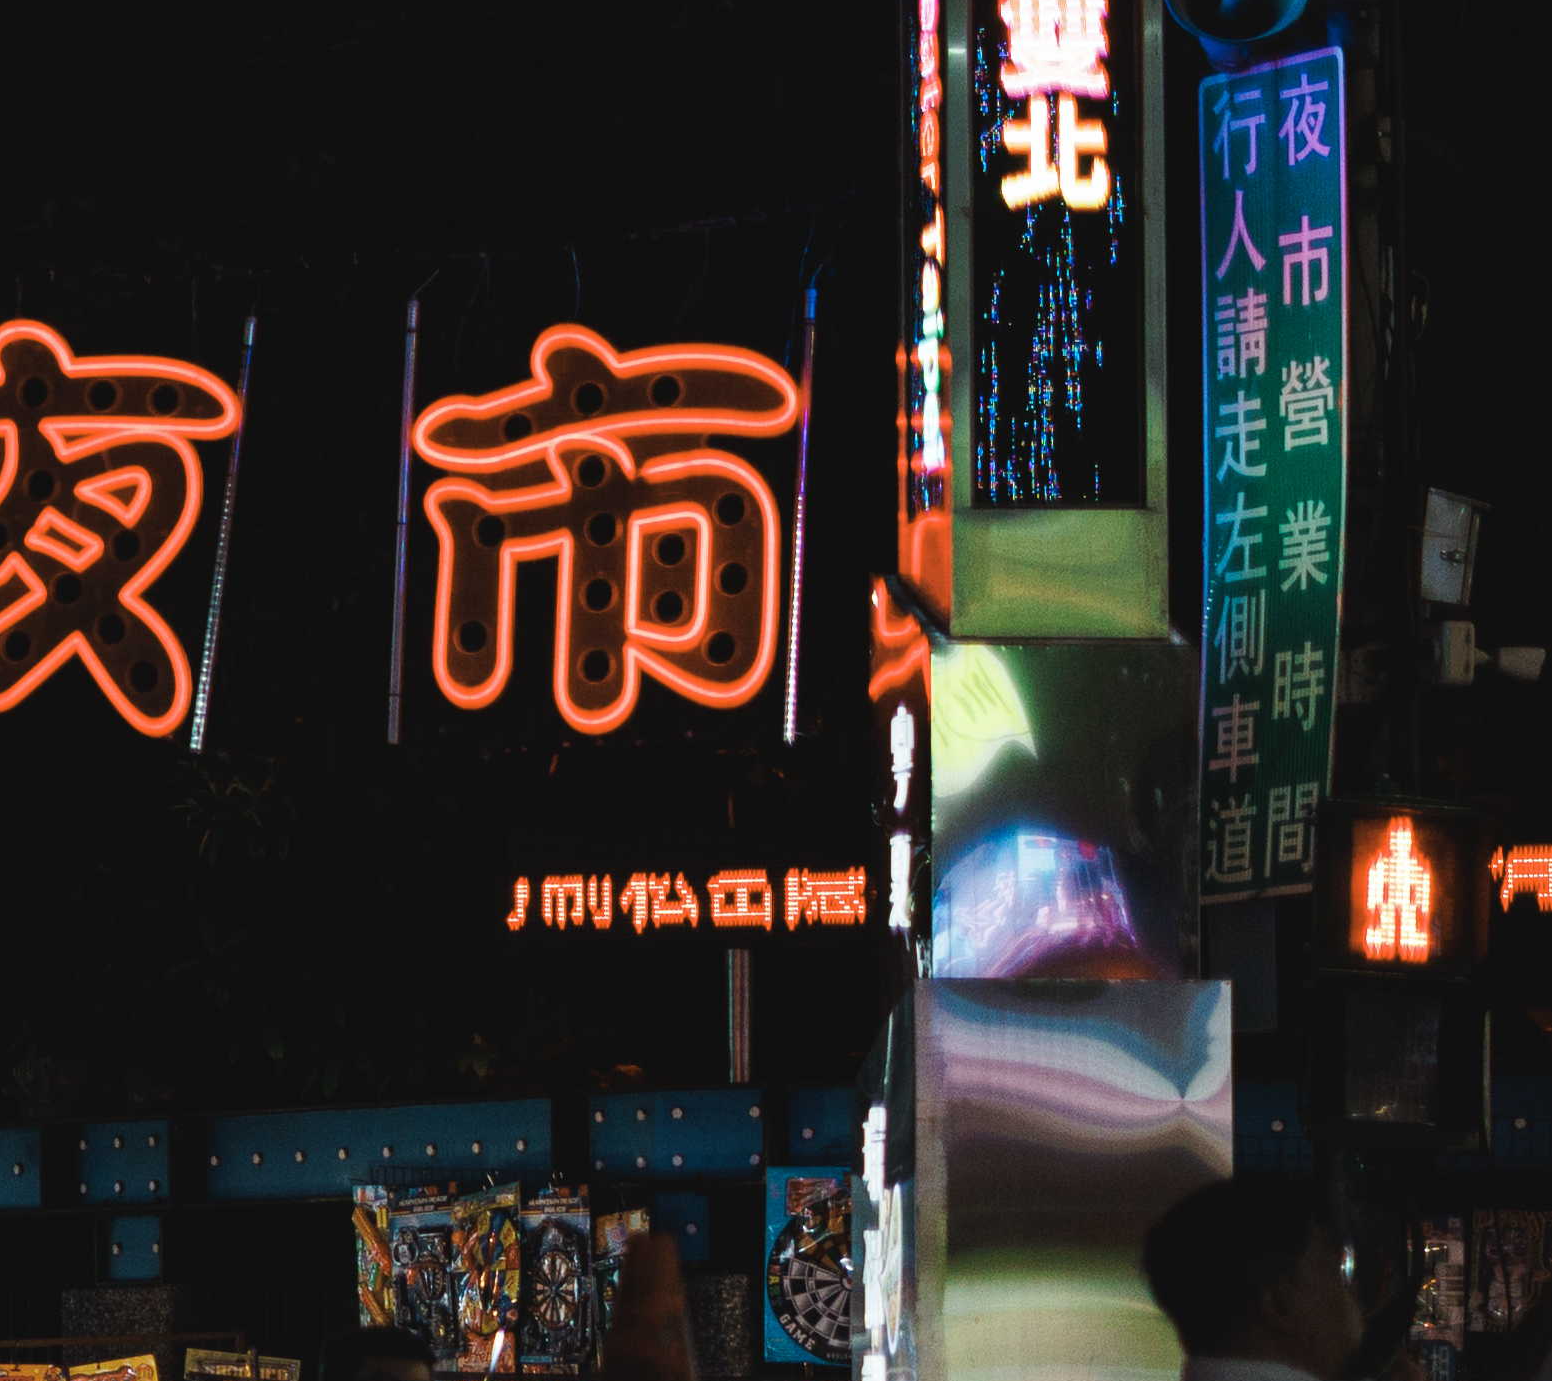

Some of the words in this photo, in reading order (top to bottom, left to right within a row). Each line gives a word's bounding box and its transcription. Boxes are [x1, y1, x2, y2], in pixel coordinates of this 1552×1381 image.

[1204, 86, 1268, 888] 行人請走左側車道
[1262, 73, 1336, 876] 夜市營業時間
[779, 1314, 817, 1351] GAME
